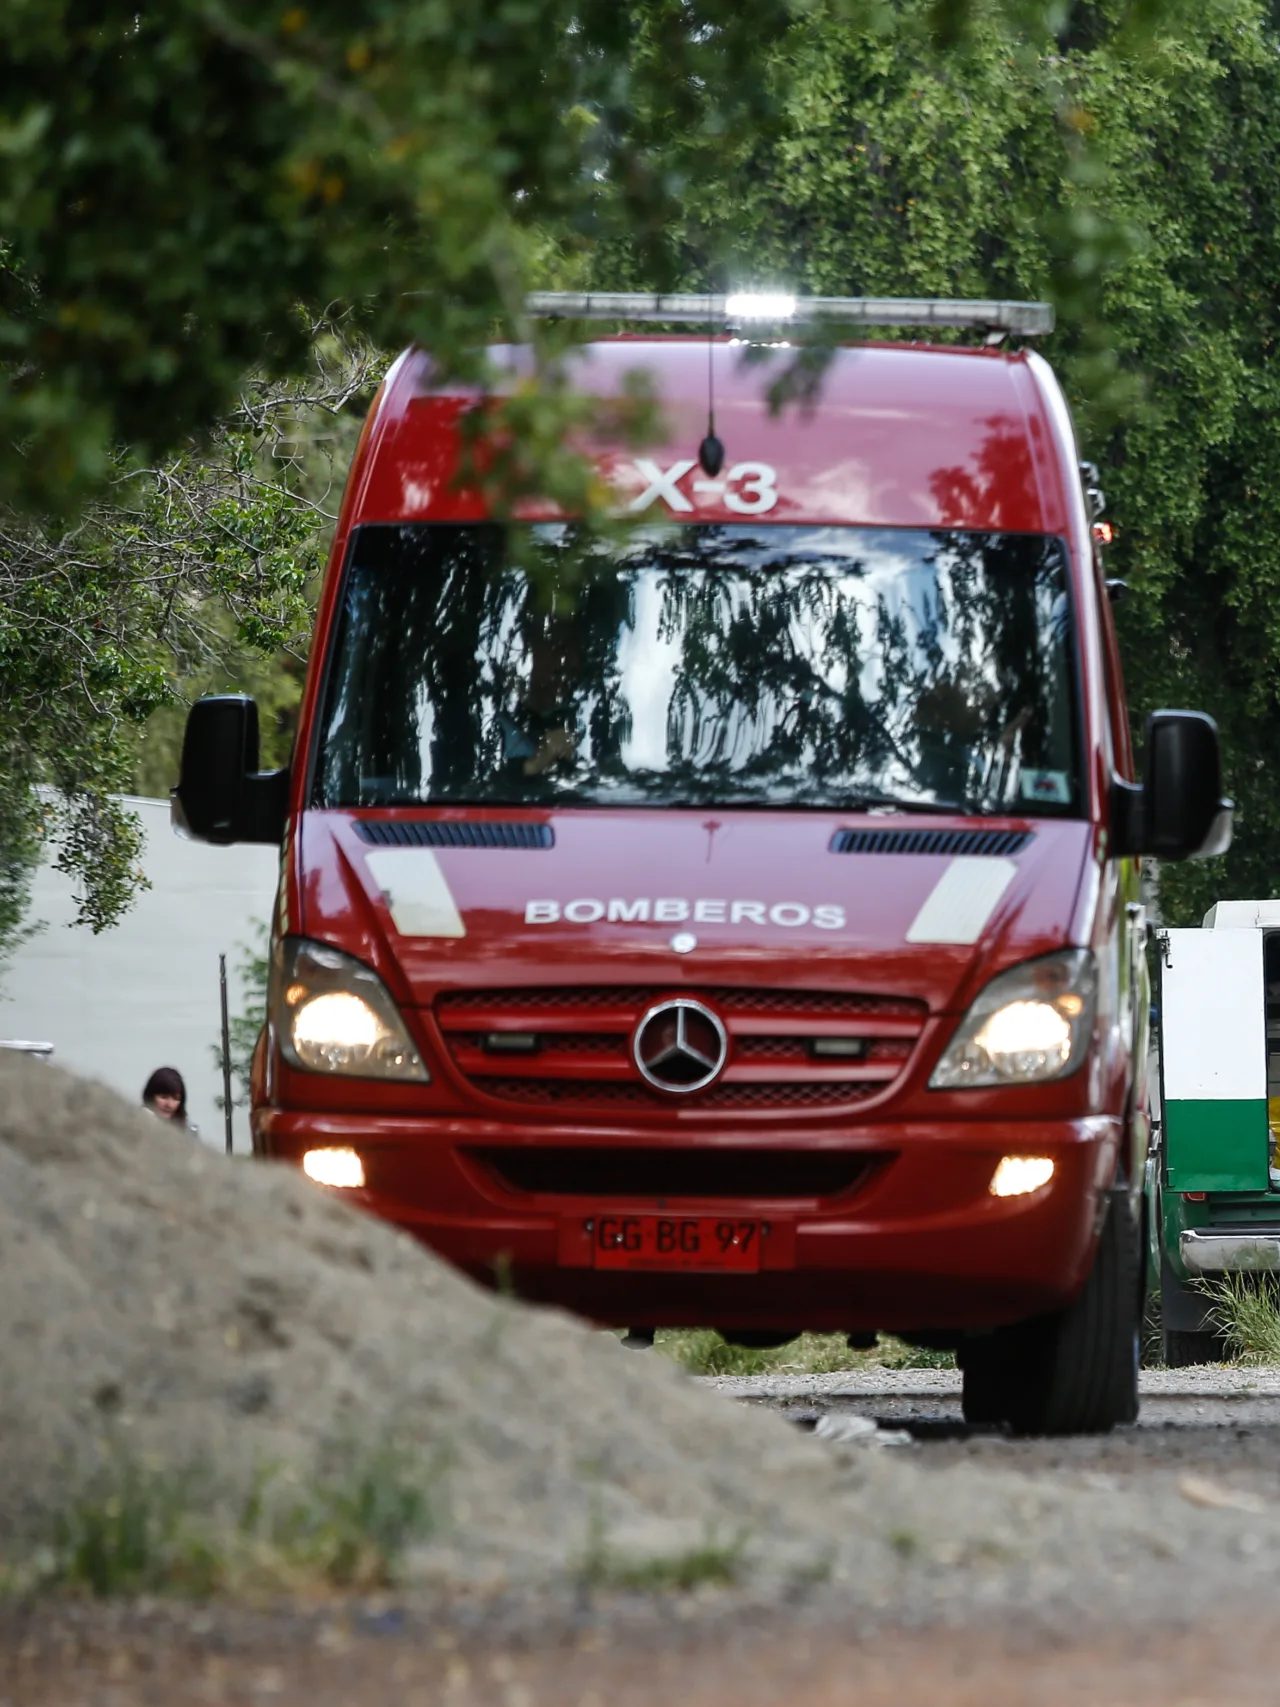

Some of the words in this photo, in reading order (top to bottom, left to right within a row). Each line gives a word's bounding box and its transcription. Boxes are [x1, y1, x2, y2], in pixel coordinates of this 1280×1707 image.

[630, 459, 778, 514] X-3
[524, 898, 847, 930] BOMBEROS
[599, 1217, 642, 1252] GG
[657, 1219, 700, 1254] BG
[715, 1221, 757, 1255] 97
